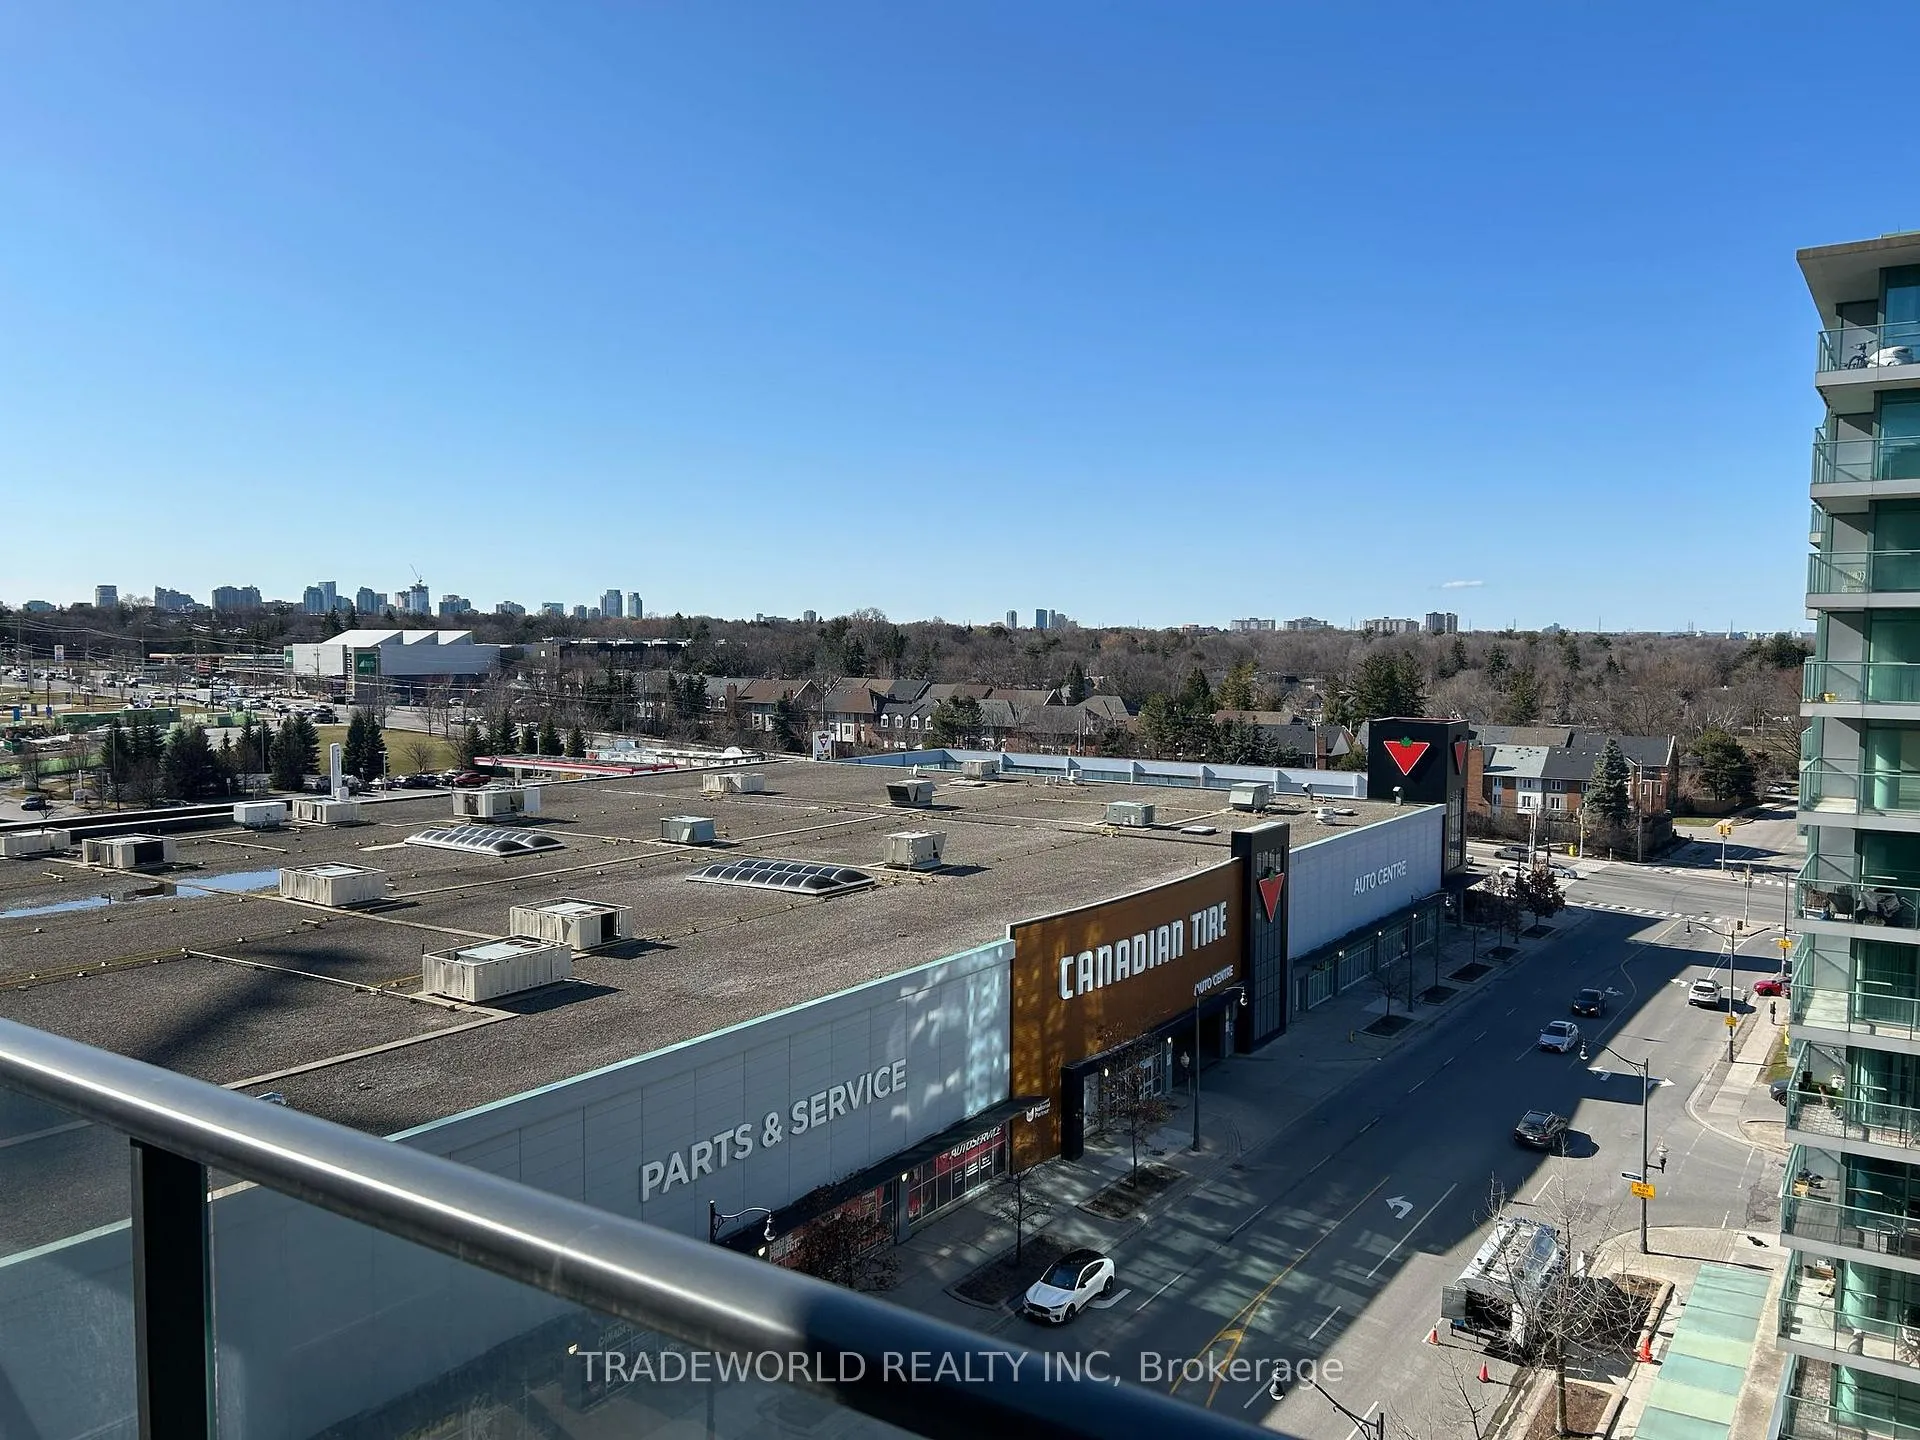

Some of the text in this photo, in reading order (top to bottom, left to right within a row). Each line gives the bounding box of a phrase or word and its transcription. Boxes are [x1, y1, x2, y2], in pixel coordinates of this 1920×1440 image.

[1353, 860, 1407, 896] AUTO CENTRE
[1059, 901, 1227, 1000] CANADIAN TIRE
[1193, 964, 1234, 997] AUTO CENTRE
[641, 1058, 908, 1202] PARTS & SERVICE
[949, 1123, 1004, 1161] AUTOSERVICE
